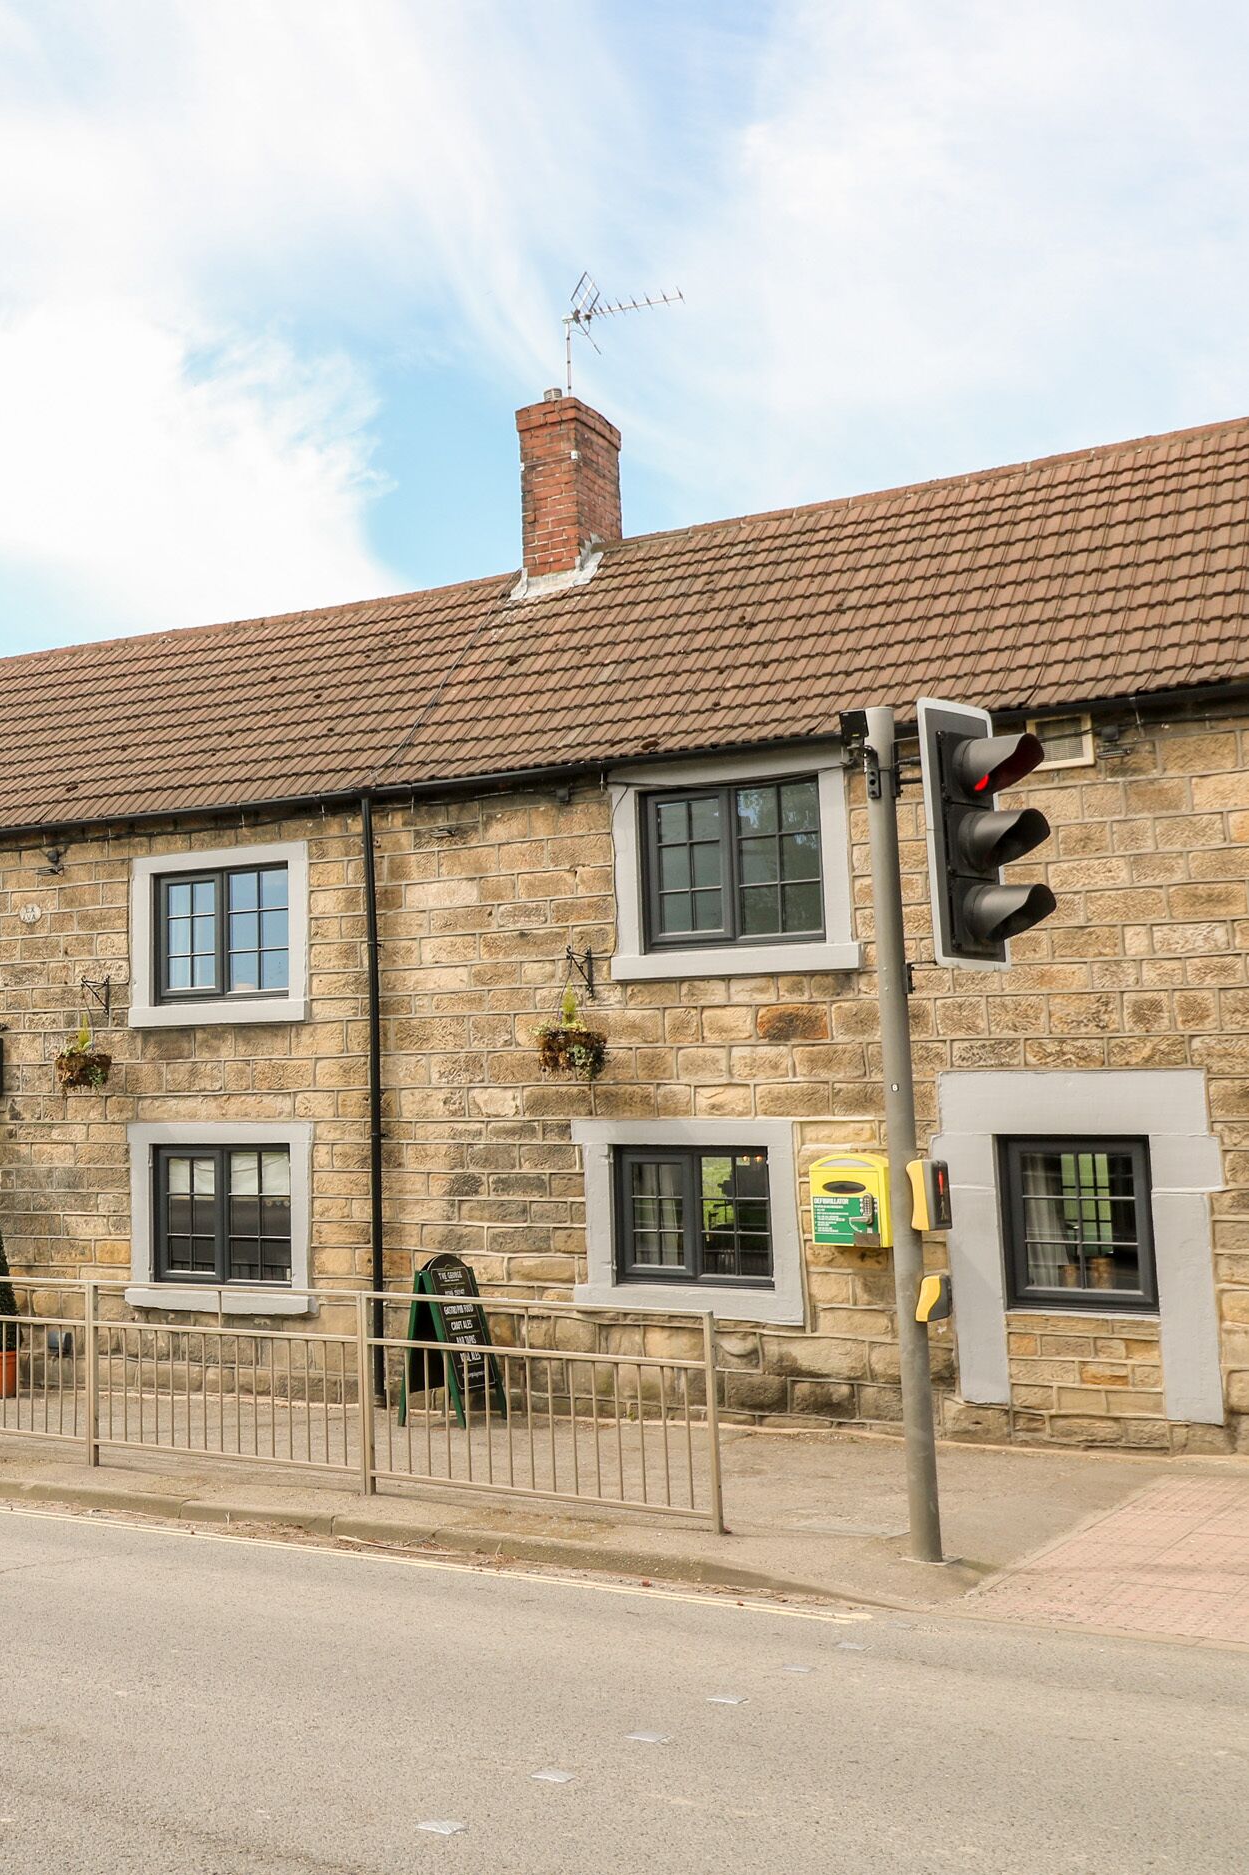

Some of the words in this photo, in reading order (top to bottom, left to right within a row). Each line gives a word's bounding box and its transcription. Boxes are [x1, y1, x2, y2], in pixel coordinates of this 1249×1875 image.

[438, 1272, 447, 1280] THE
[447, 1271, 462, 1279] GEORGE
[443, 1305, 457, 1315] GASTRO
[463, 1303, 473, 1313] FOOD
[451, 1320, 463, 1330] CRAFT
[463, 1319, 473, 1329] ALES
